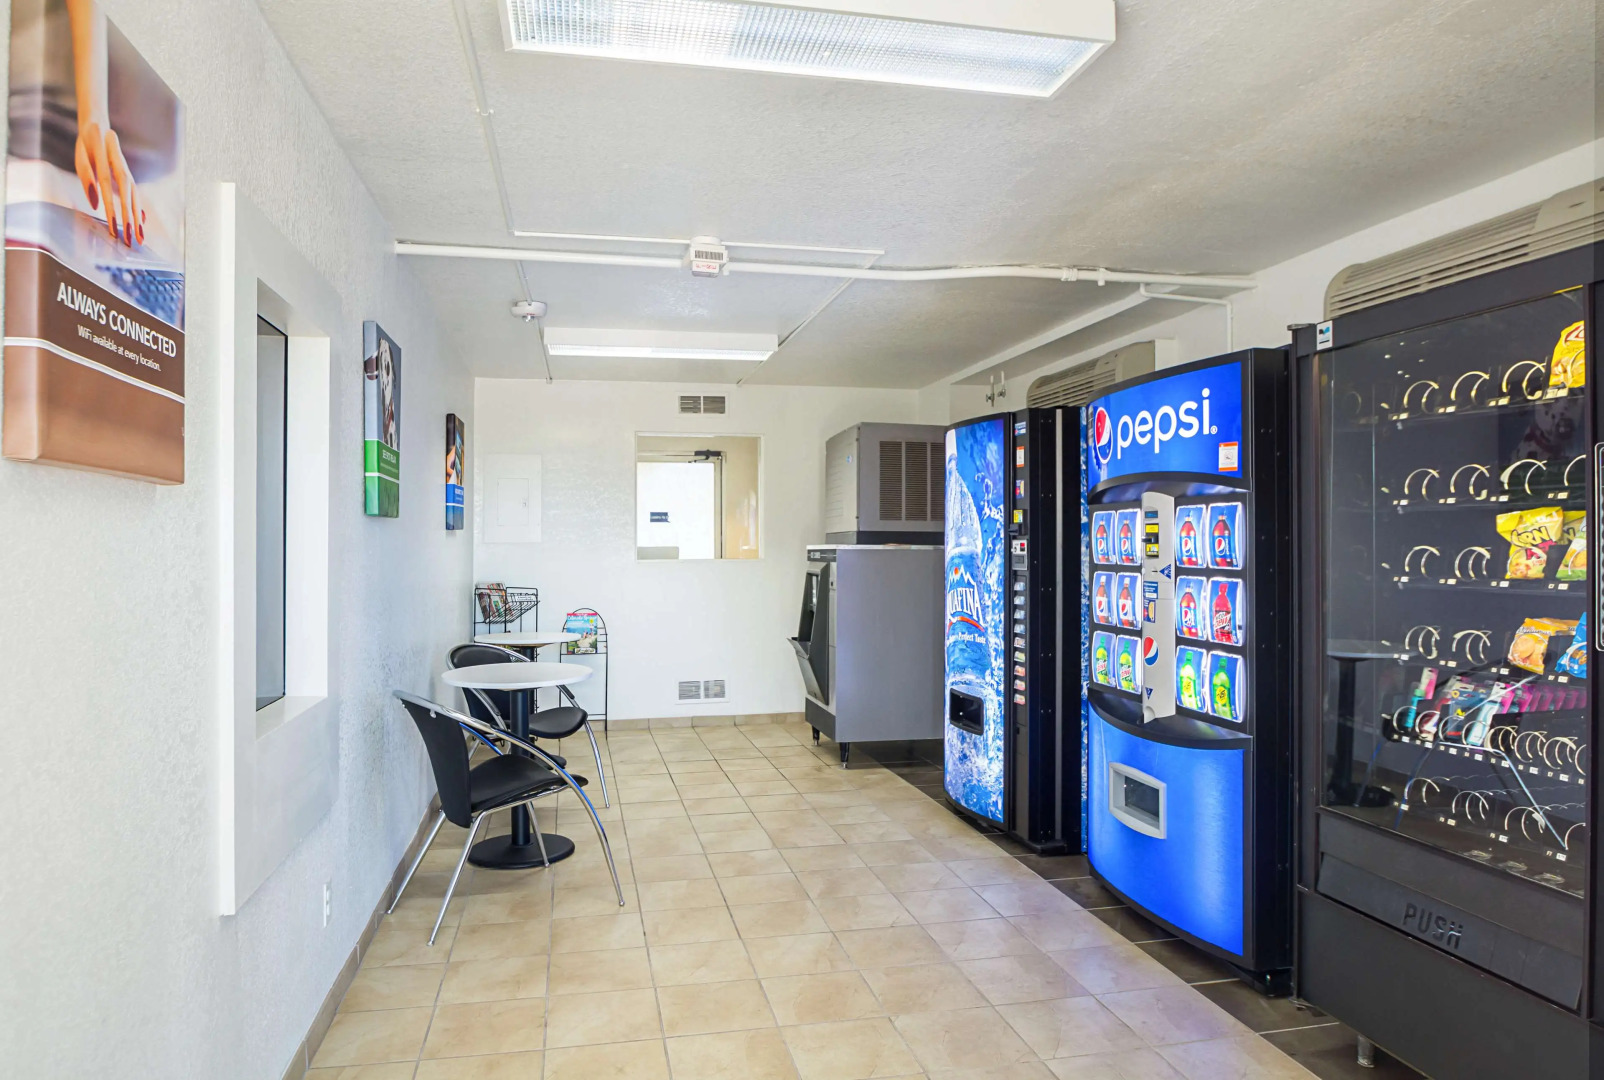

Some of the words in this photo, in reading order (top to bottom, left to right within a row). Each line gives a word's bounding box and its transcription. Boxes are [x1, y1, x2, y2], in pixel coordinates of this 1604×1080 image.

[57, 282, 106, 325] ALWAYS
[109, 310, 176, 357] CONNECTED
[78, 324, 92, 341] WiFi
[93, 333, 117, 353] available
[118, 346, 124, 356] at
[124, 350, 139, 365] every
[140, 352, 161, 371] location.
[1117, 387, 1210, 460] pepsi
[1402, 902, 1464, 949] PUSH
